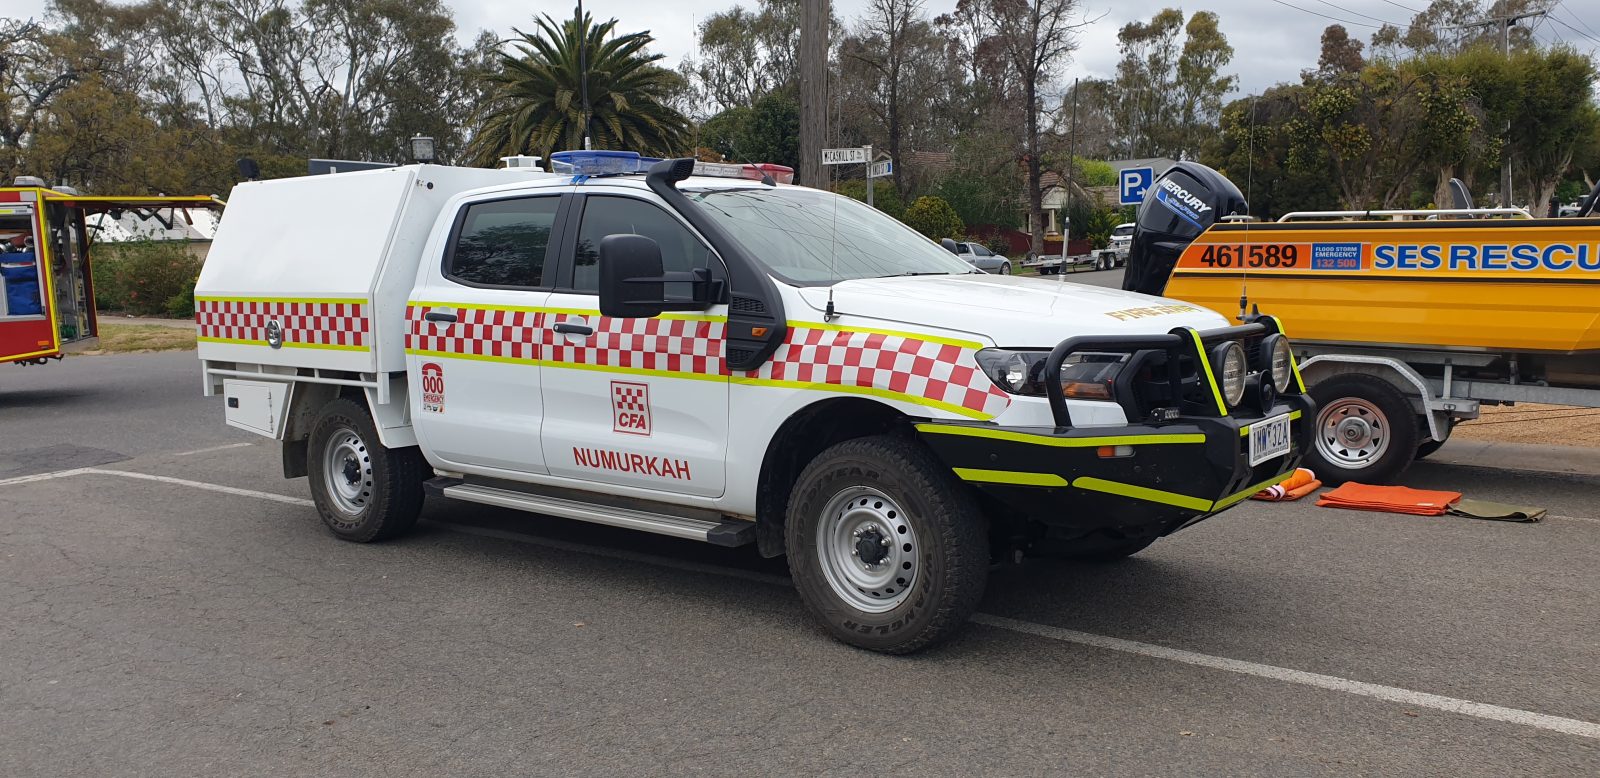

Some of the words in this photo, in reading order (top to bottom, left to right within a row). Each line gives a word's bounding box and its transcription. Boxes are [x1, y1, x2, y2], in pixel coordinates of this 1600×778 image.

[850, 150, 855, 160] ST
[1124, 173, 1142, 197] P
[1159, 177, 1212, 213] MERCURY
[1201, 244, 1298, 268] 461589
[1316, 259, 1334, 268] 132
[1337, 259, 1356, 268] 500
[1375, 244, 1441, 269] SES
[422, 375, 444, 394] 000
[618, 412, 646, 429] CFA
[573, 446, 691, 480] NUMURKAH
[843, 553, 933, 636] WRANGLER
